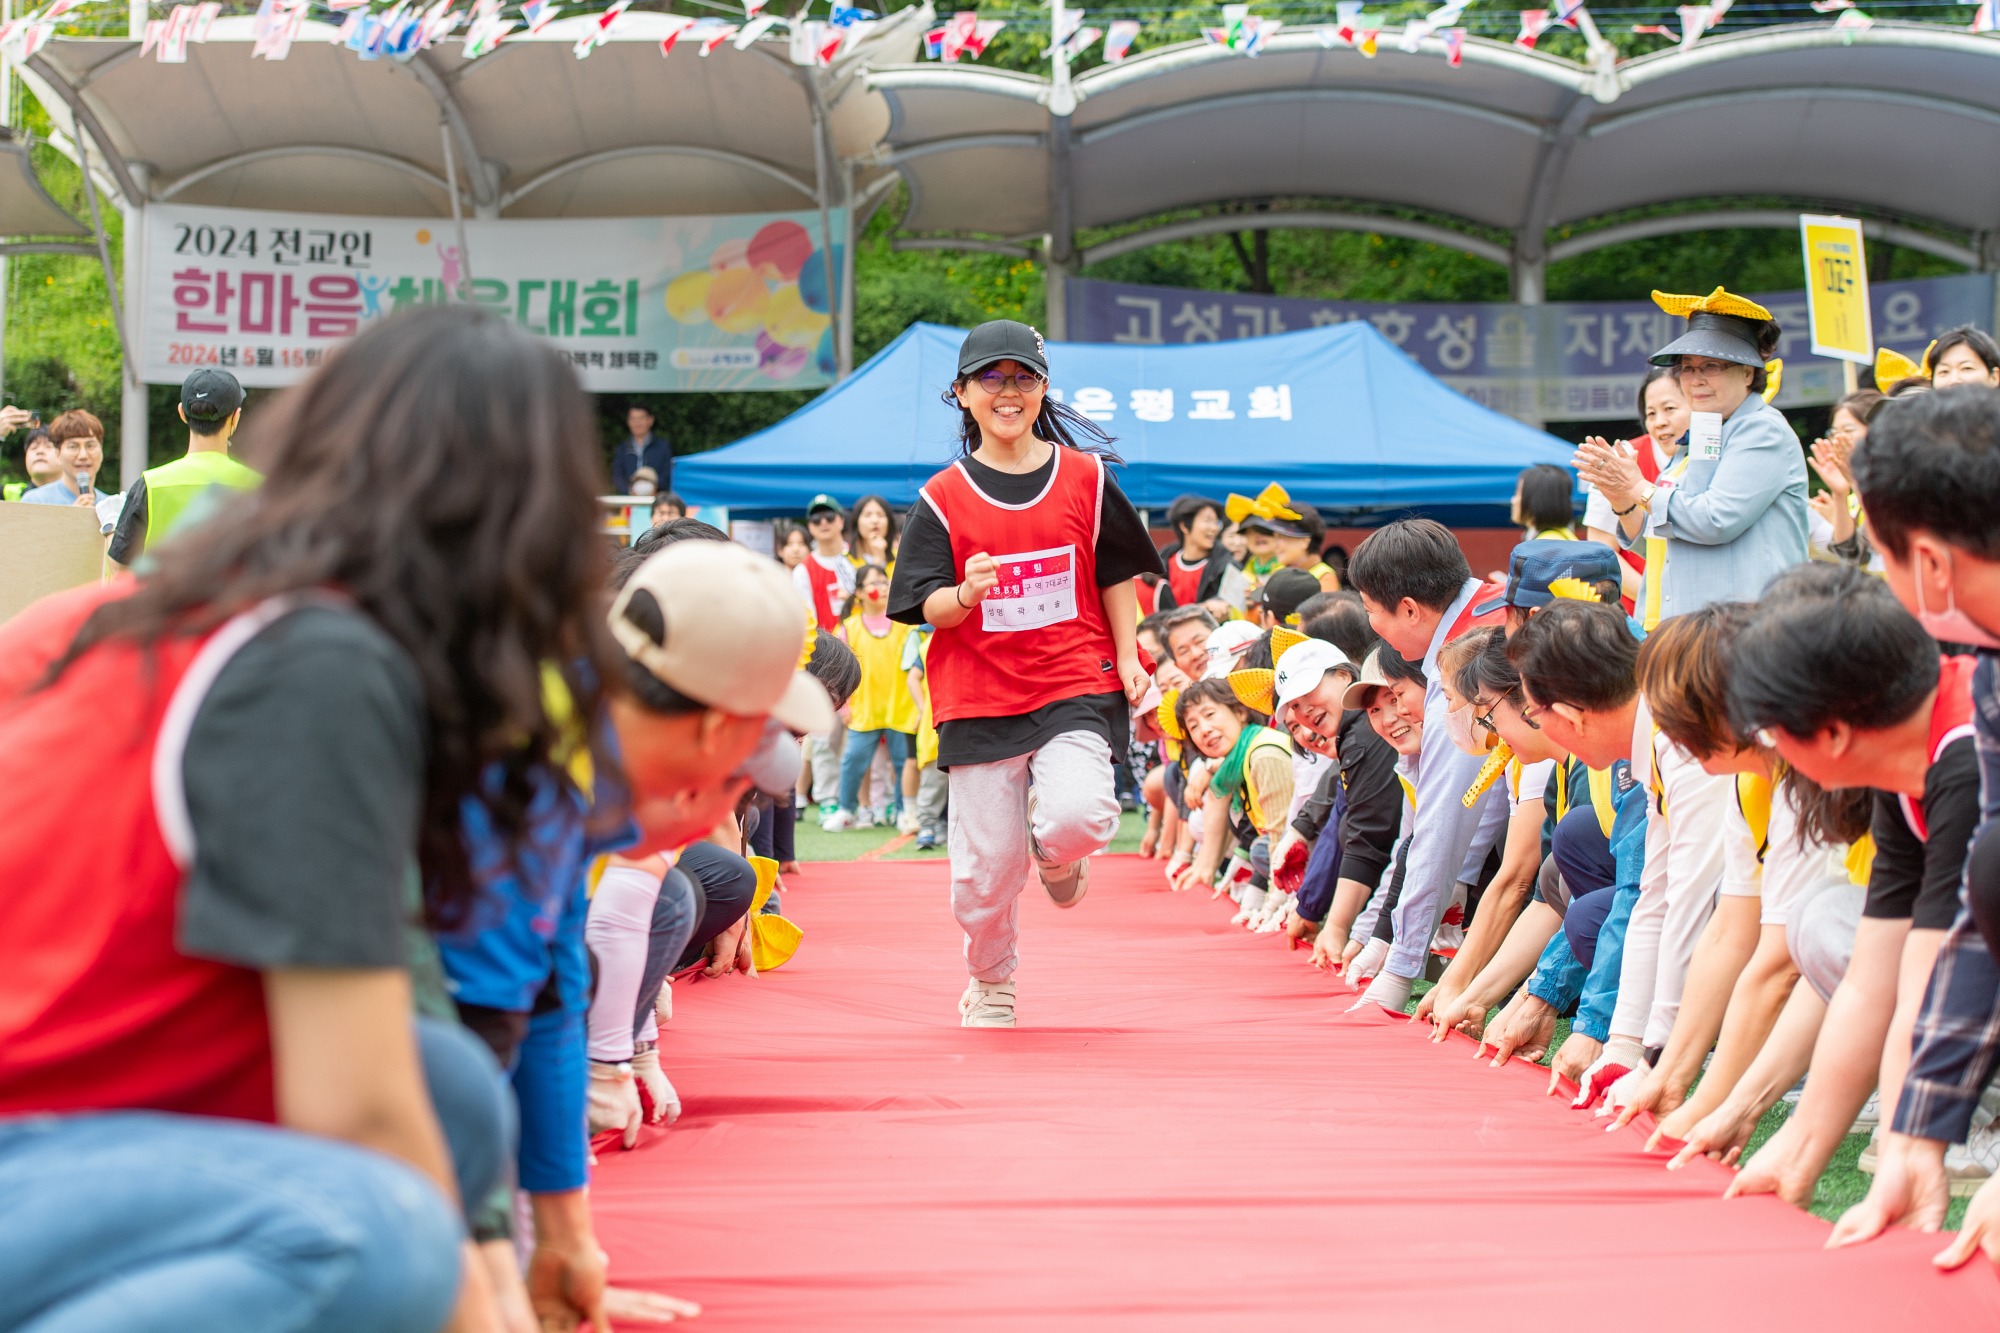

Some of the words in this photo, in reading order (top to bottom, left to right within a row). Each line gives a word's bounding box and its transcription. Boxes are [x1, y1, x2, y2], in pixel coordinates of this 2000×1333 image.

[174, 223, 258, 258] 2024
[268, 227, 372, 268] 전교인
[173, 266, 362, 338] 한마음
[168, 343, 237, 367] 2024년
[243, 346, 275, 368] 5월
